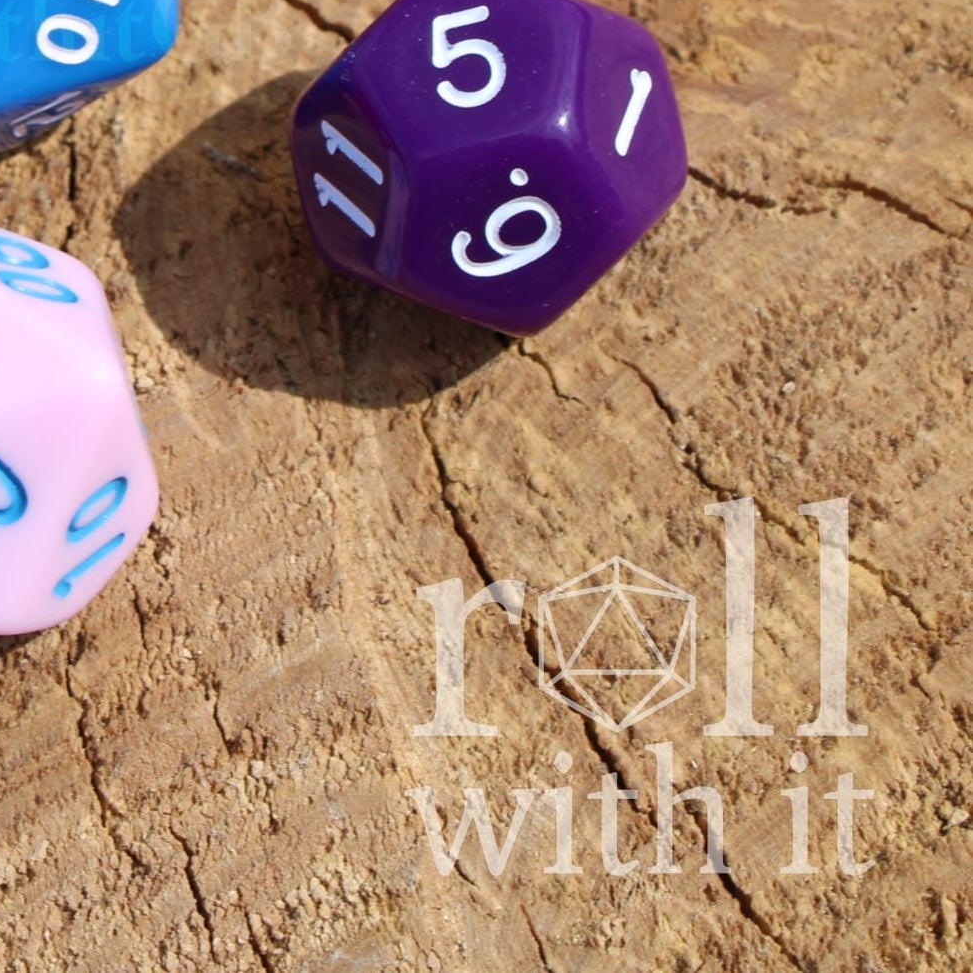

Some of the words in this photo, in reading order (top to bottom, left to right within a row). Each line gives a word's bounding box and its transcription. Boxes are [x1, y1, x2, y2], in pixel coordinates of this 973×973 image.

[432, 5, 507, 108] 5
[615, 68, 653, 157] 1
[314, 120, 384, 238] 11
